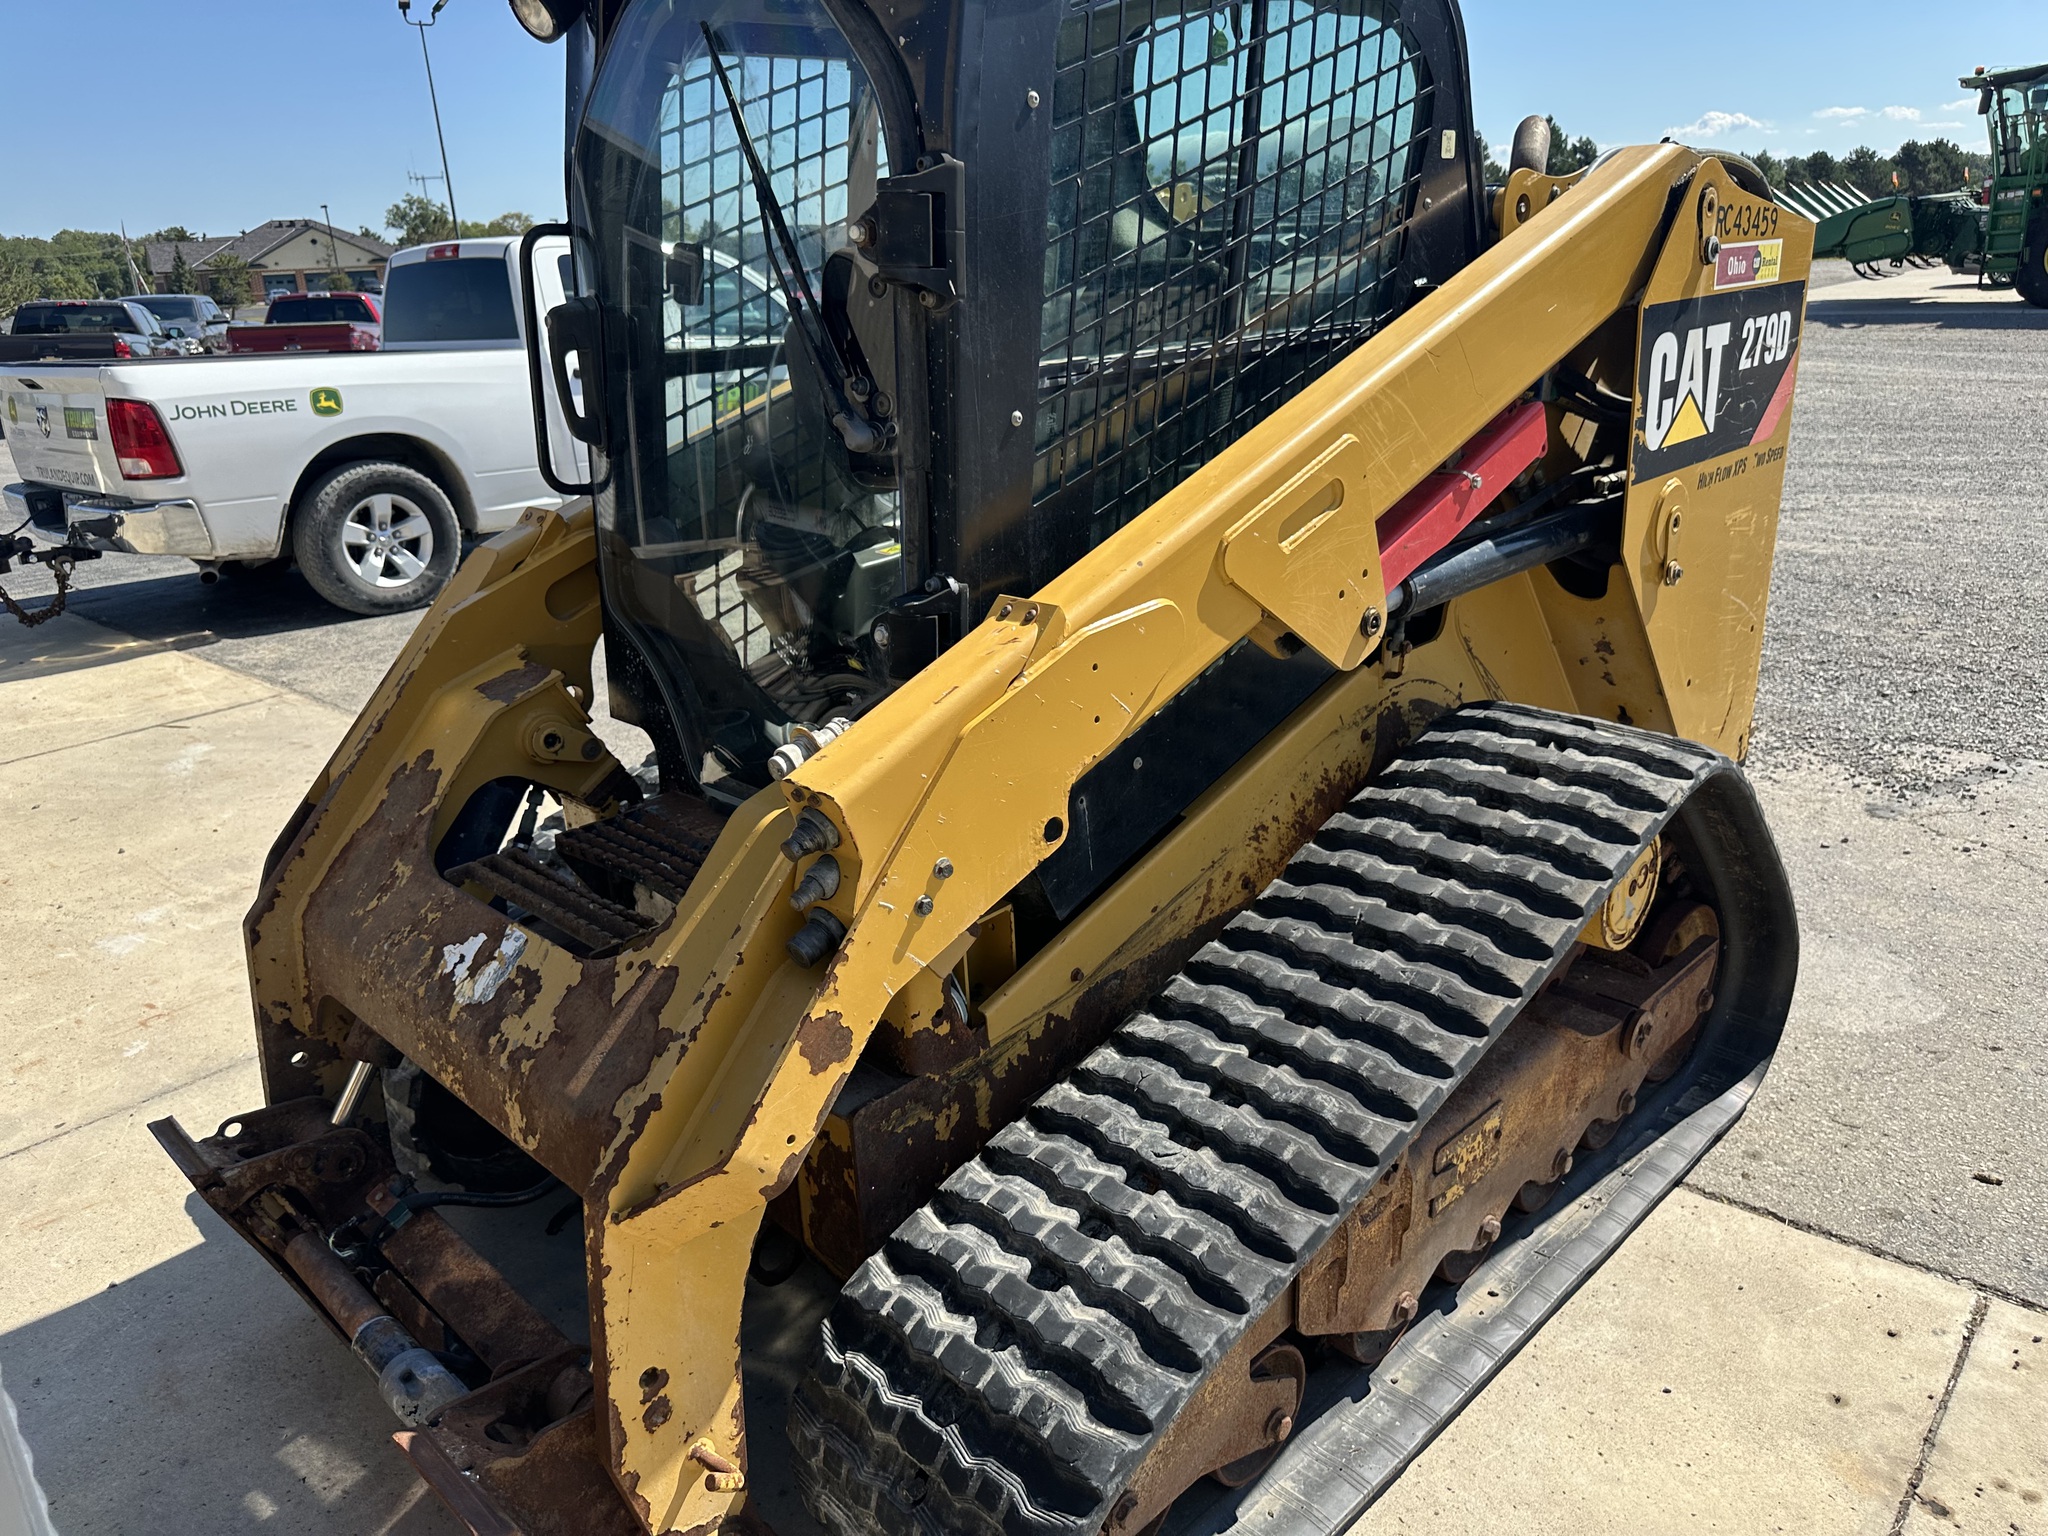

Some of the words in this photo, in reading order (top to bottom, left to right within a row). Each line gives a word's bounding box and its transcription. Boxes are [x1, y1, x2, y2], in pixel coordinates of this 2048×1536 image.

[1715, 204, 1778, 238] RC43459
[1727, 256, 1746, 276] Ohio
[1762, 256, 1777, 267] Rental
[1738, 310, 1792, 371] 279D
[1645, 322, 1731, 451] CAT
[169, 404, 227, 421] JOHN
[230, 399, 297, 416] DEERE
